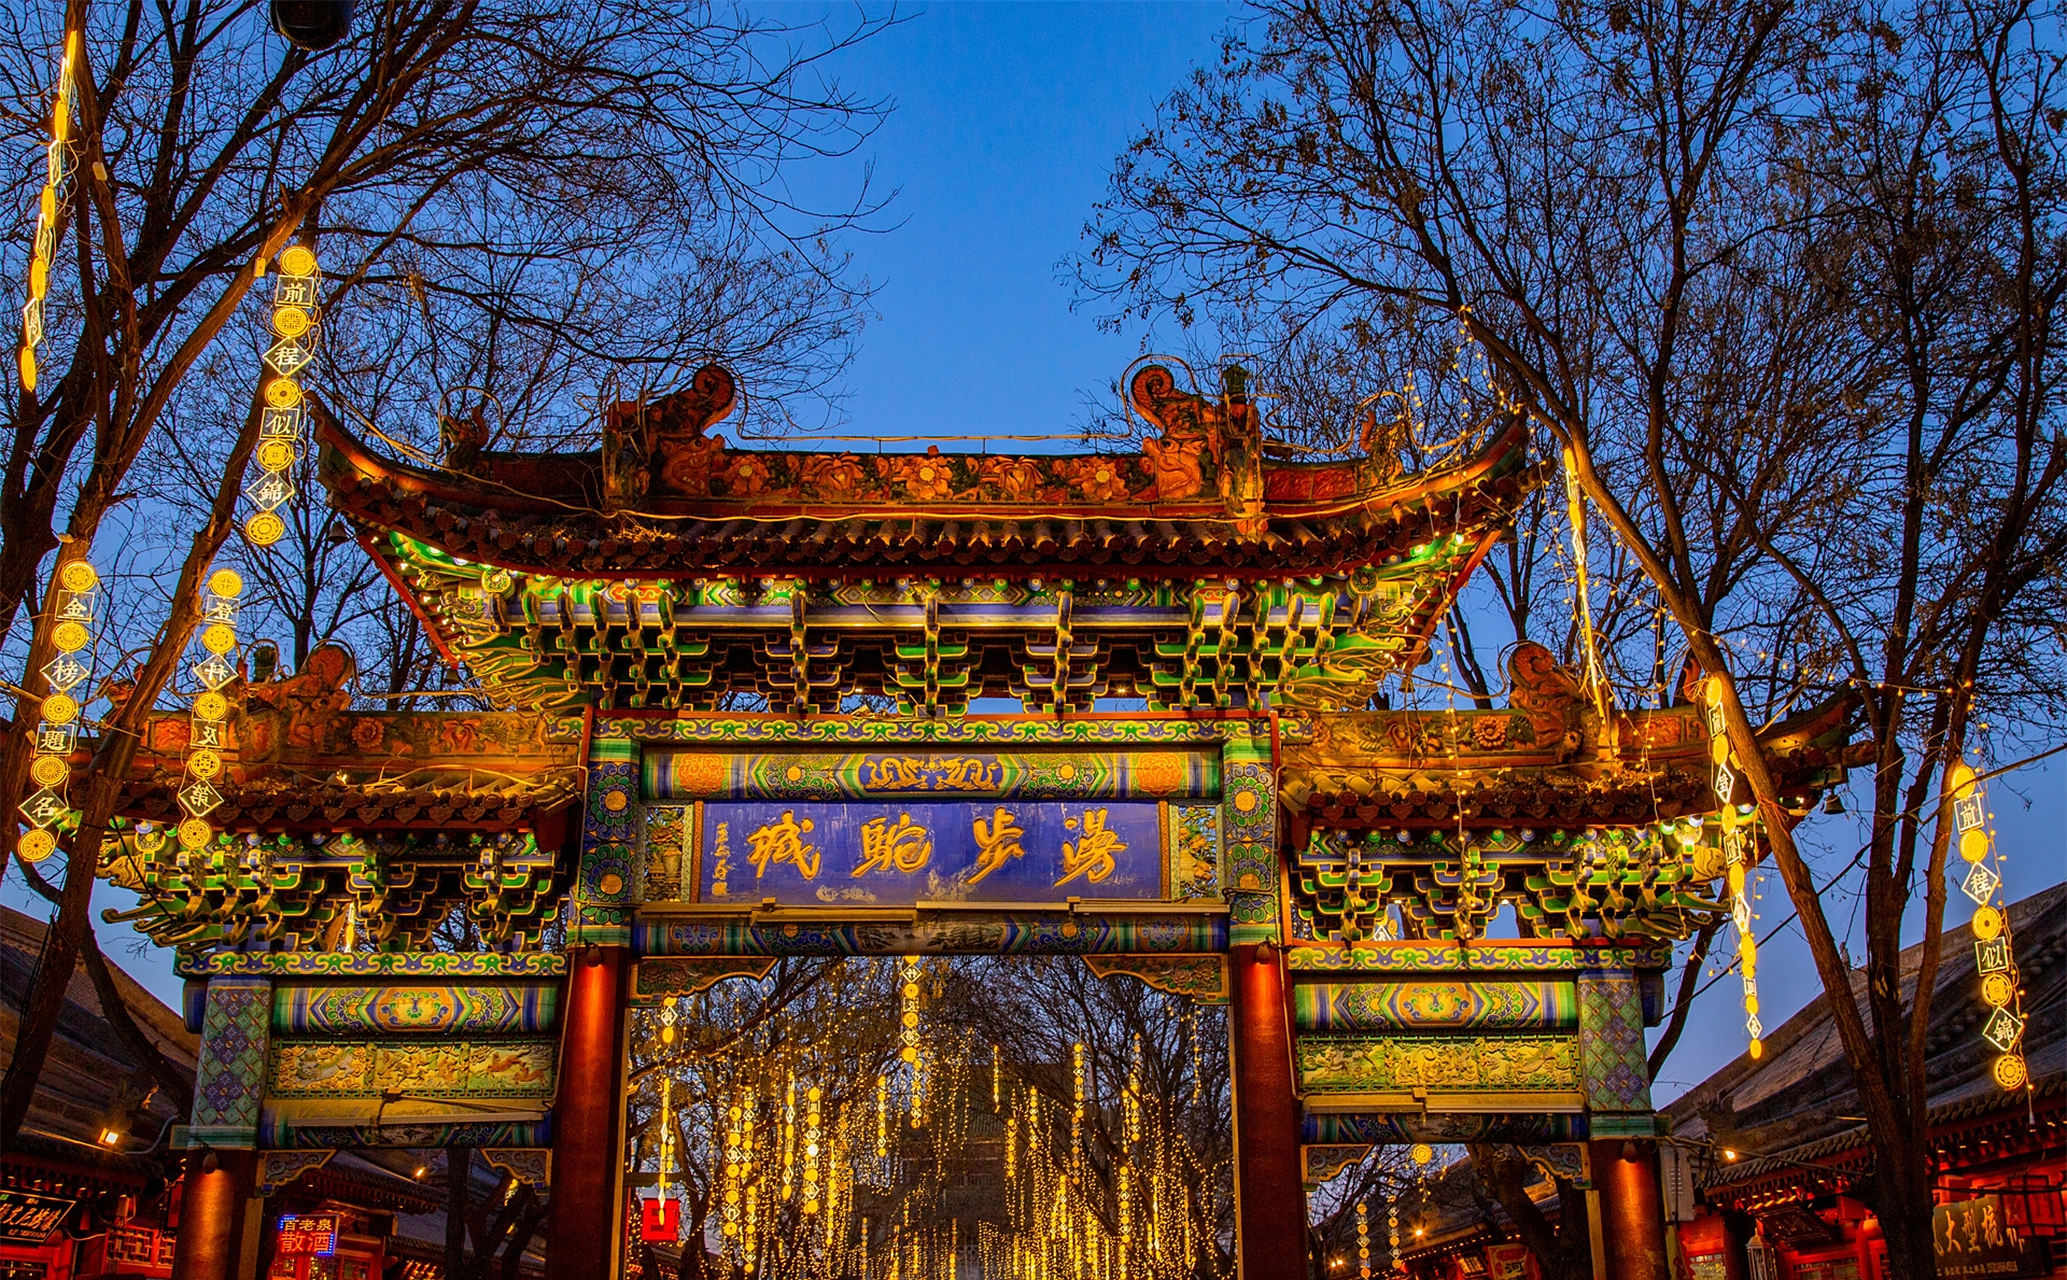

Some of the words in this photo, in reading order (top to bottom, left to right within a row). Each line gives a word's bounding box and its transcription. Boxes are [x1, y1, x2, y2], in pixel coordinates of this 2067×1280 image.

[283, 1218, 332, 1231] 百老泉
[281, 1231, 331, 1253] 散酒
